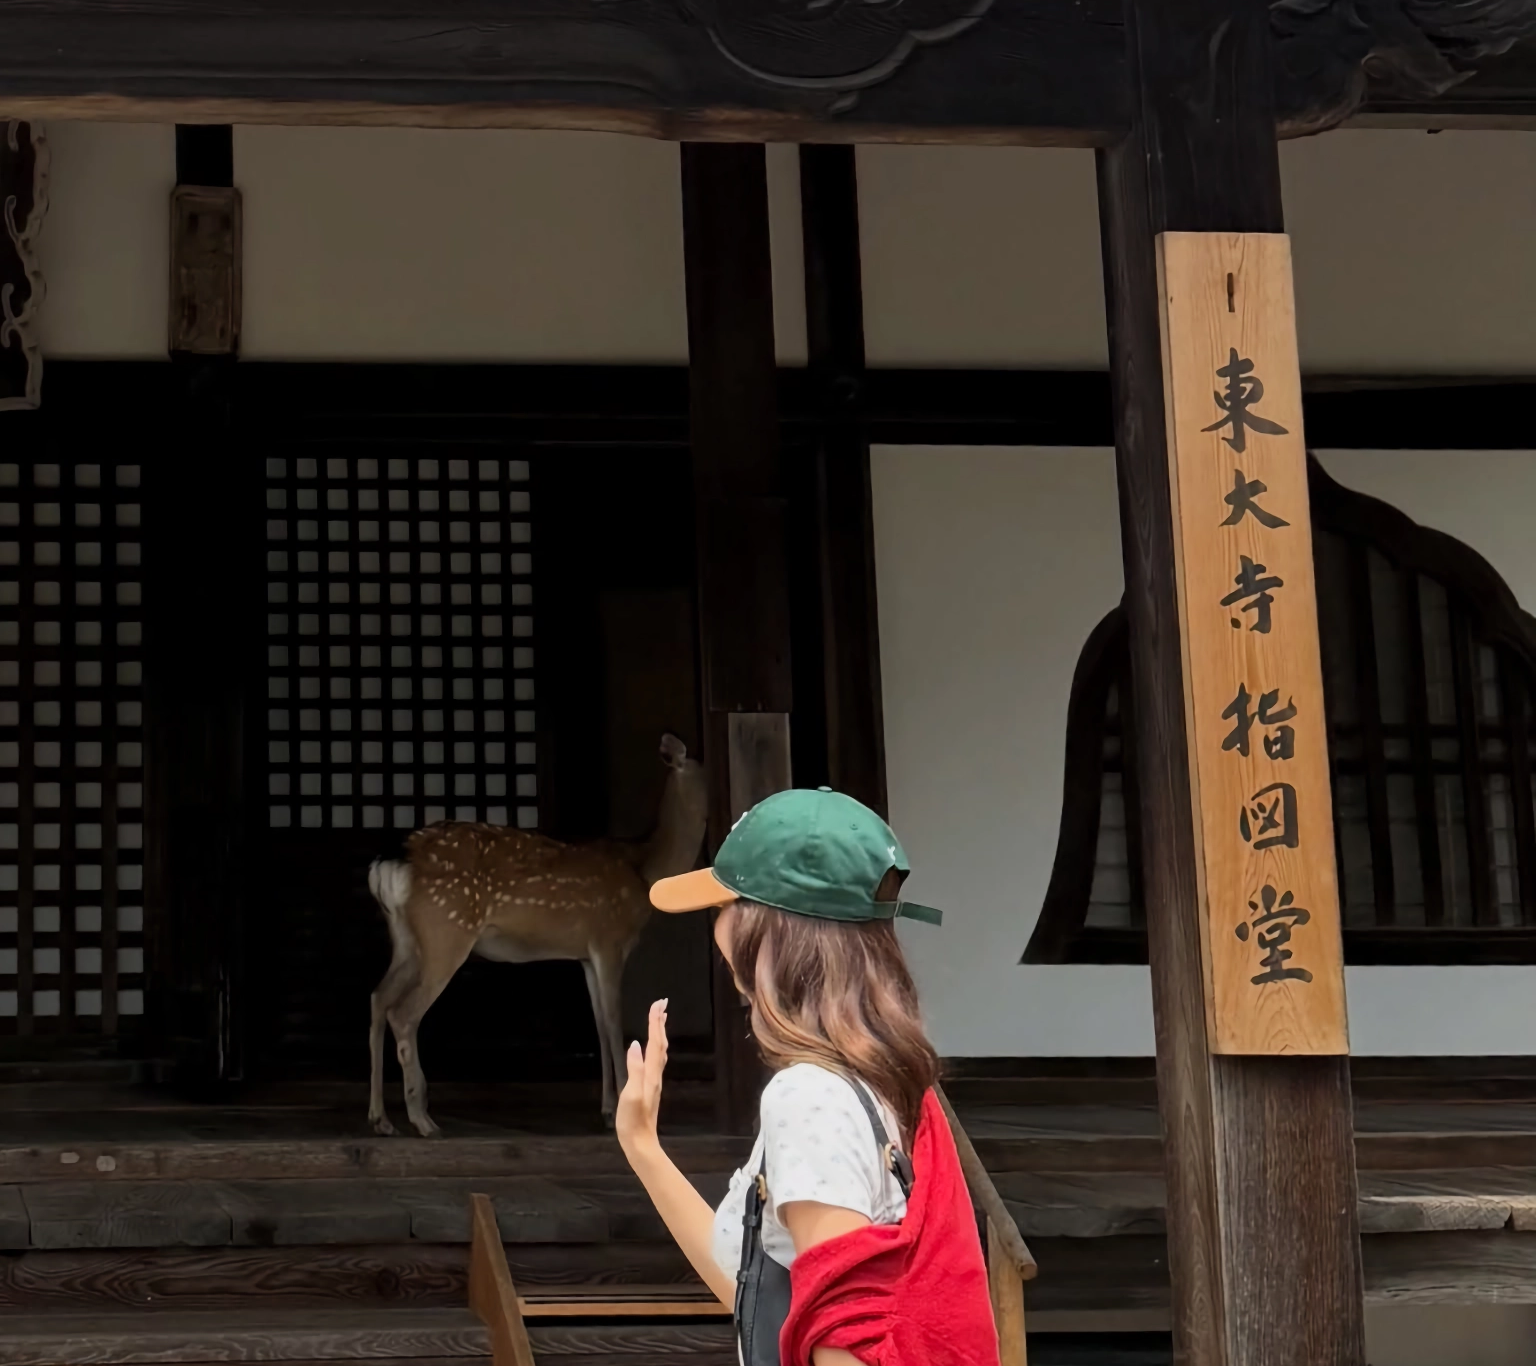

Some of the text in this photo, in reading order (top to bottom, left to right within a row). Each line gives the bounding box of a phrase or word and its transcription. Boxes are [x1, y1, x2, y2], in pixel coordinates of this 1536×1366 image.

[1200, 347, 1313, 985] 東大寺指図堂
